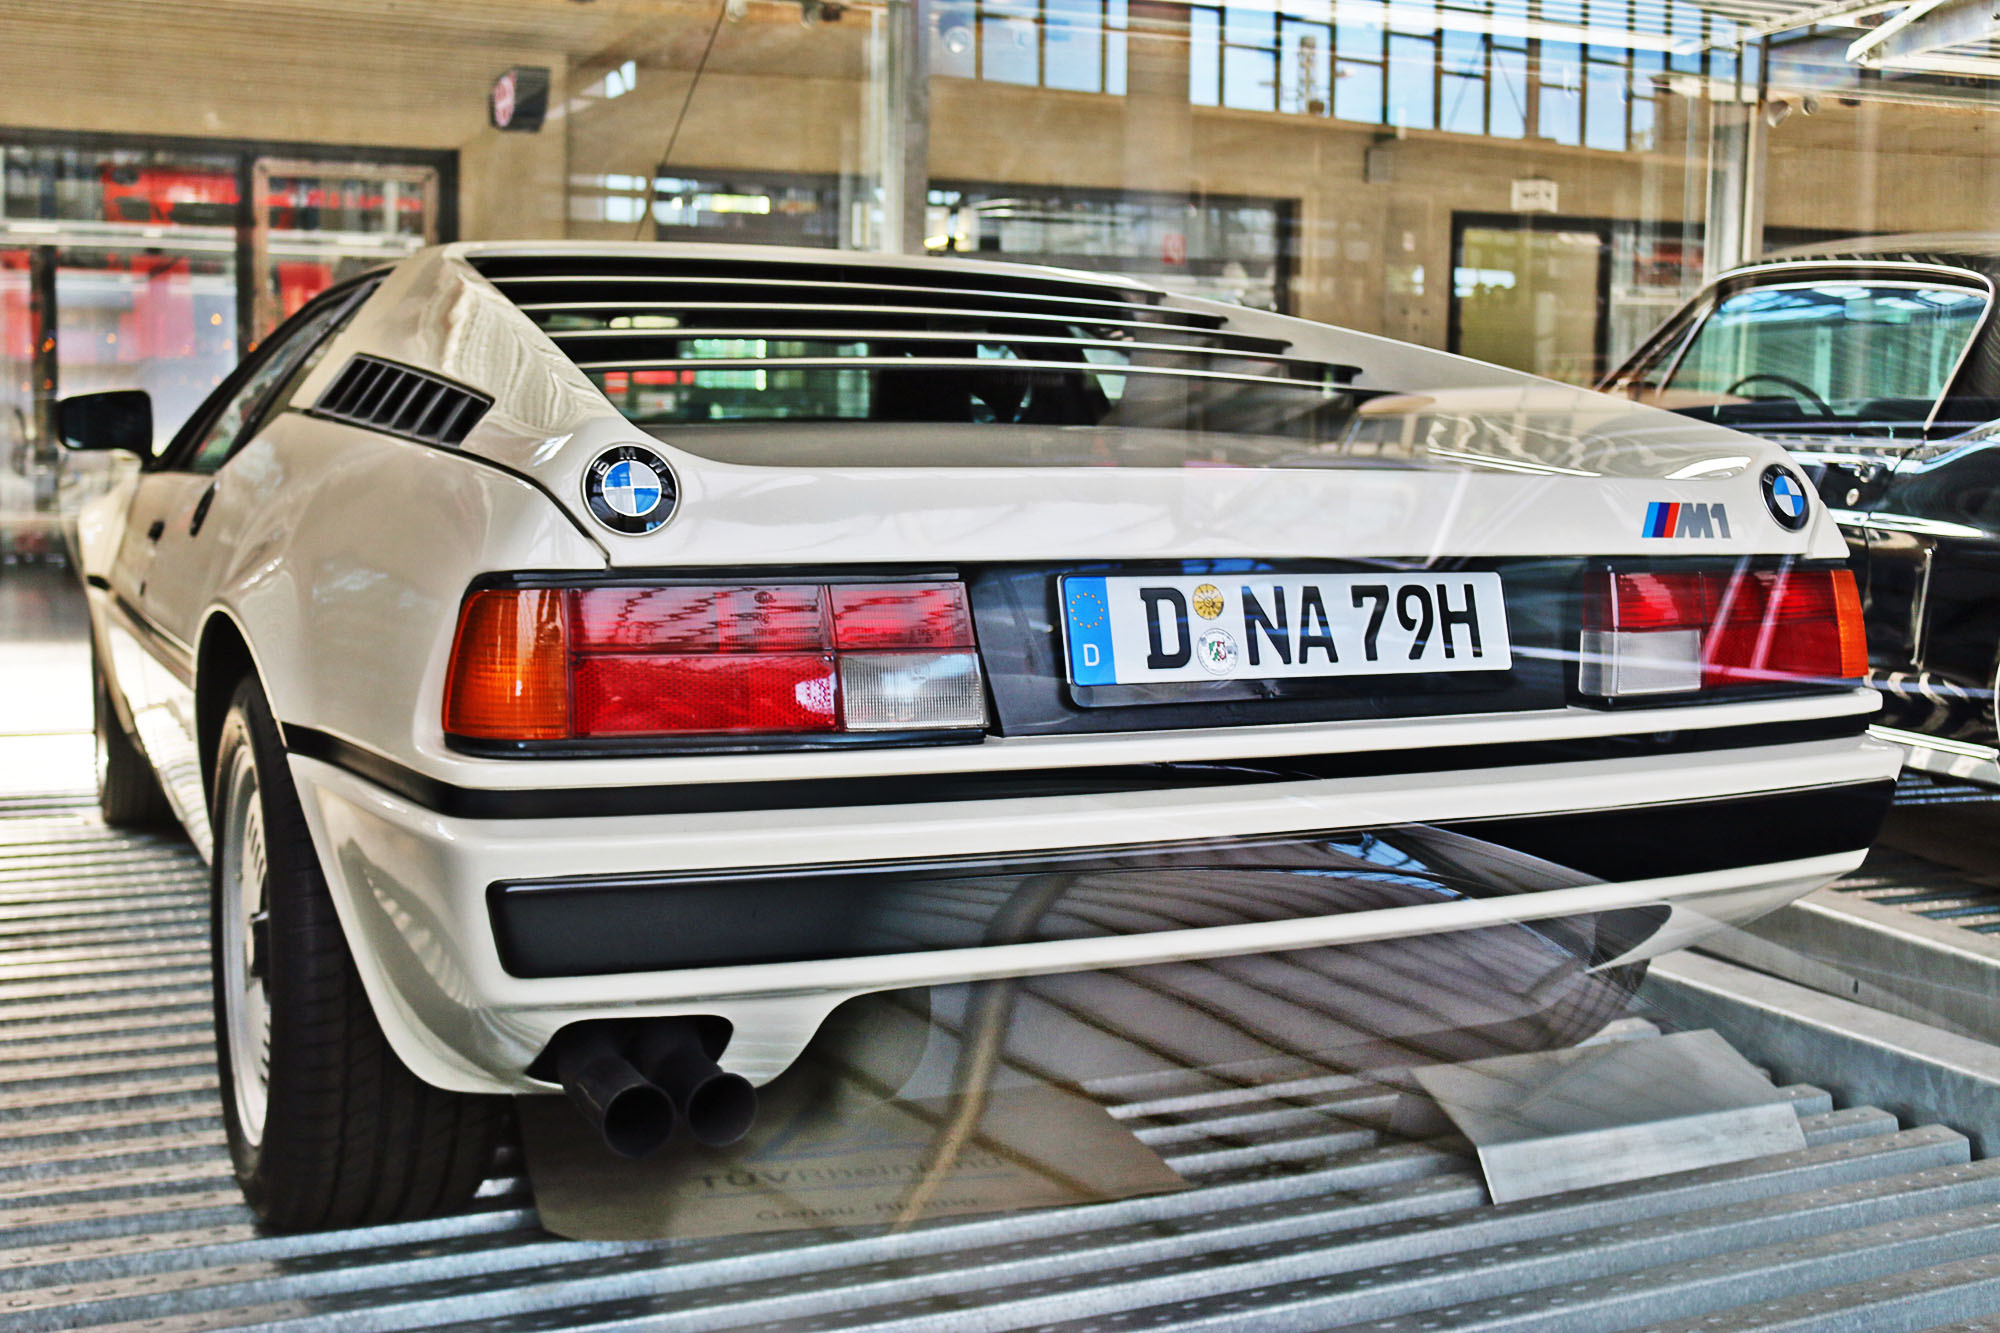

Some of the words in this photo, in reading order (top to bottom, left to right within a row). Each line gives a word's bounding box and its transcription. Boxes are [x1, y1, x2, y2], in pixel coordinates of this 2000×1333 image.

[592, 447, 666, 476] BMW
[1676, 502, 1731, 539] M1
[1140, 587, 1192, 670] D
[1241, 585, 1339, 666] NA
[1351, 583, 1483, 662] 79H
[1082, 643, 1101, 667] D
